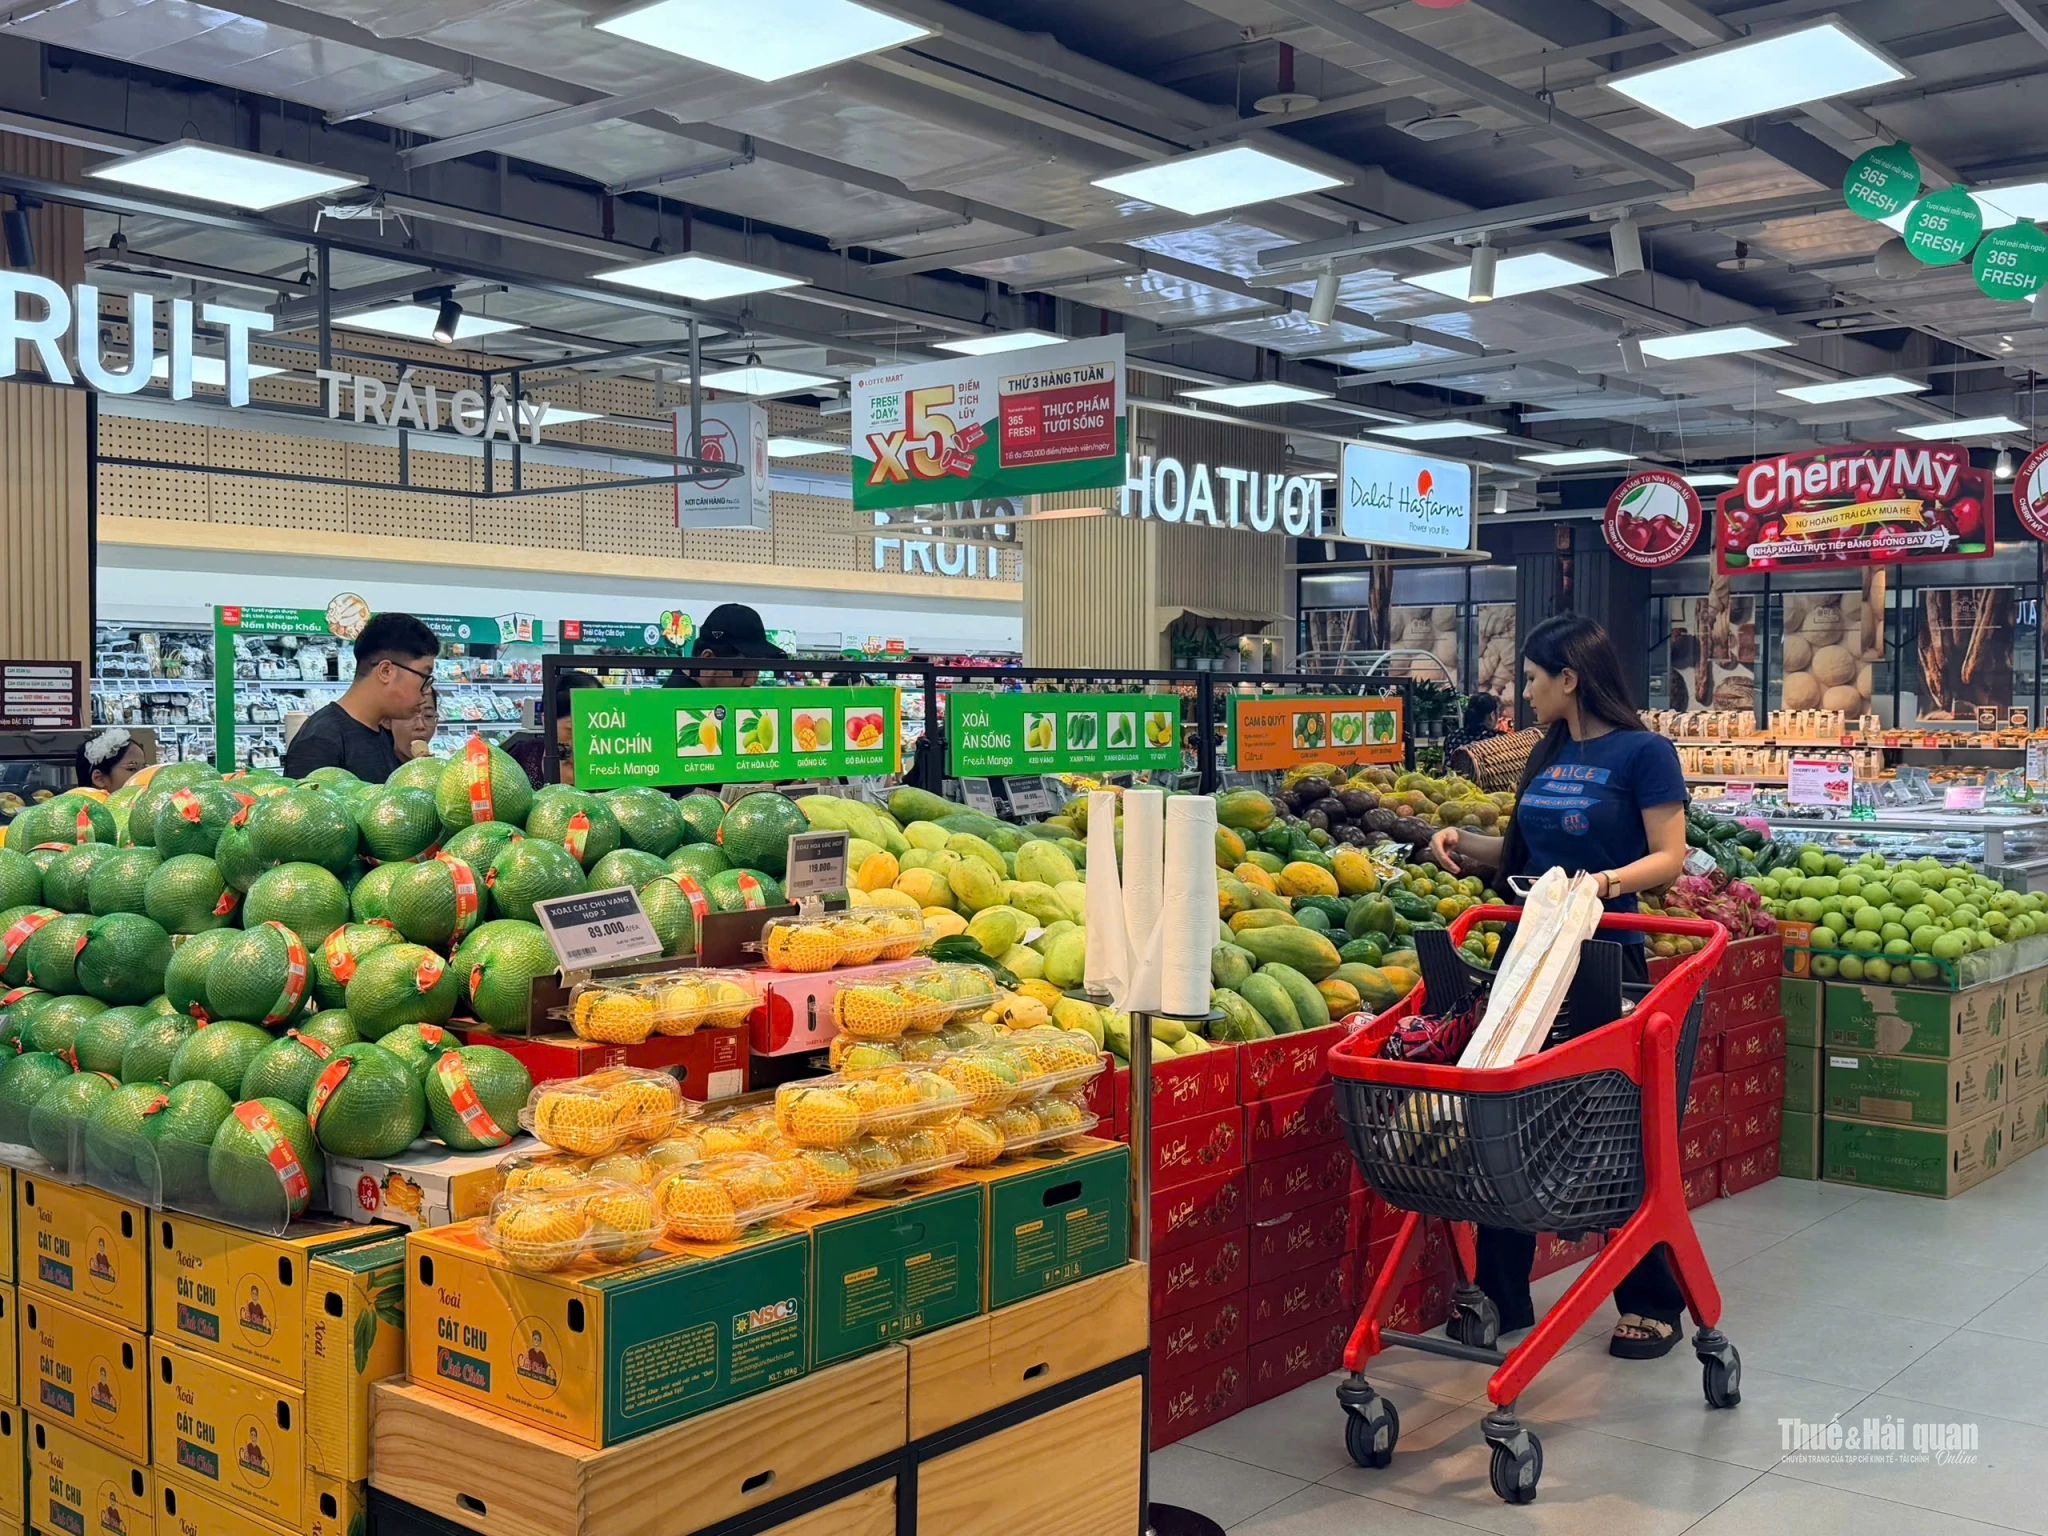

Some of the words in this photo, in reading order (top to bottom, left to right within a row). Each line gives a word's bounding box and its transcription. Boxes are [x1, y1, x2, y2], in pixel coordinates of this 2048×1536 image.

[1859, 166, 1888, 187] 365
[1849, 182, 1898, 213] FRESH
[1918, 213, 1949, 232] 365
[1911, 231, 1965, 255] FRESH
[1986, 249, 2018, 267] 365
[1981, 268, 2037, 289] FRESH
[0, 270, 274, 408] RUIT
[865, 378, 884, 386] LOTTE
[885, 374, 904, 382] MART
[958, 378, 980, 392] ĐIỂM
[1008, 375, 1031, 391] THỨ
[1032, 377, 1039, 388] 3
[1040, 371, 1071, 387] HÀNG
[1073, 366, 1104, 383] TUẦN
[316, 368, 438, 433] TRÁI
[449, 384, 551, 445] CÂY
[871, 395, 898, 408] FRESH
[958, 393, 979, 406] TÍCH
[1043, 402, 1074, 418] THỰC
[1076, 395, 1110, 412] PHẨM
[876, 408, 894, 420] DAY
[959, 407, 976, 419] LŨY
[1008, 415, 1023, 426] 365
[1043, 420, 1070, 434] TƯƠI
[1073, 413, 1104, 430] SỐNG
[1008, 425, 1036, 438] FRESH
[1351, 476, 1394, 509] Dalat
[1398, 486, 1463, 522] Hasfarm
[1796, 519, 1808, 529] NỮ
[1809, 515, 1838, 527] HOÀNG
[1839, 511, 1859, 521] TRÁI
[1860, 507, 1878, 517] CÂY
[1879, 505, 1899, 515] MÙA
[1900, 505, 1911, 515] HÈ
[1753, 545, 1778, 556] NHẬP
[1778, 542, 1803, 553] KHẨU
[1803, 543, 1827, 553] TRỰC
[1828, 540, 1846, 550] TIẾP
[1847, 538, 1872, 548] BẰNG
[1872, 536, 1906, 547] ĐƯỜNG
[1907, 535, 1926, 544] BAY
[588, 707, 626, 729] XOÀI
[962, 709, 989, 727] XOÀI
[1244, 716, 1261, 727] CAM
[1261, 716, 1267, 726] &
[1267, 713, 1286, 726] QUÝT
[588, 734, 611, 755] ĂN
[614, 732, 652, 754] CHÍN
[962, 731, 979, 748] ĂN
[981, 729, 1011, 748] SỐNG
[589, 762, 621, 775] Fresh
[623, 762, 660, 776] Mango
[684, 762, 698, 772] CÁT
[699, 763, 715, 771] CHU
[736, 760, 749, 769] CÁT
[963, 755, 986, 766] Fresh
[986, 755, 1013, 767] Mango
[1543, 765, 1597, 780] POLICE
[550, 906, 572, 916] XOAI
[573, 903, 588, 913] CAT
[589, 899, 606, 909] CHU
[607, 895, 629, 906] VANG
[582, 911, 600, 920] HOP
[588, 921, 625, 939] 89.000
[37, 1206, 53, 1223] Xoài
[38, 1230, 53, 1252] CÁT
[54, 1240, 70, 1258] CHU
[176, 1250, 195, 1269] Xoài
[176, 1275, 194, 1298] CÁT
[196, 1285, 216, 1307] CHU
[437, 1286, 462, 1309] Xoài
[749, 1297, 798, 1330] NSC9
[39, 1330, 55, 1349] Xoài
[314, 1319, 326, 1358] Xoài
[437, 1316, 460, 1344] CÁT
[463, 1325, 488, 1353] CHU
[40, 1354, 54, 1376] CÁT
[56, 1364, 73, 1385] CHU
[438, 1347, 462, 1377] Chú
[462, 1361, 488, 1389] Chín
[175, 1385, 194, 1406] Xoài
[176, 1411, 194, 1434] CÁT
[196, 1420, 216, 1445] CHU
[48, 1451, 64, 1471] Xoài
[49, 1474, 64, 1496] CÁT
[65, 1485, 82, 1507] CHU
